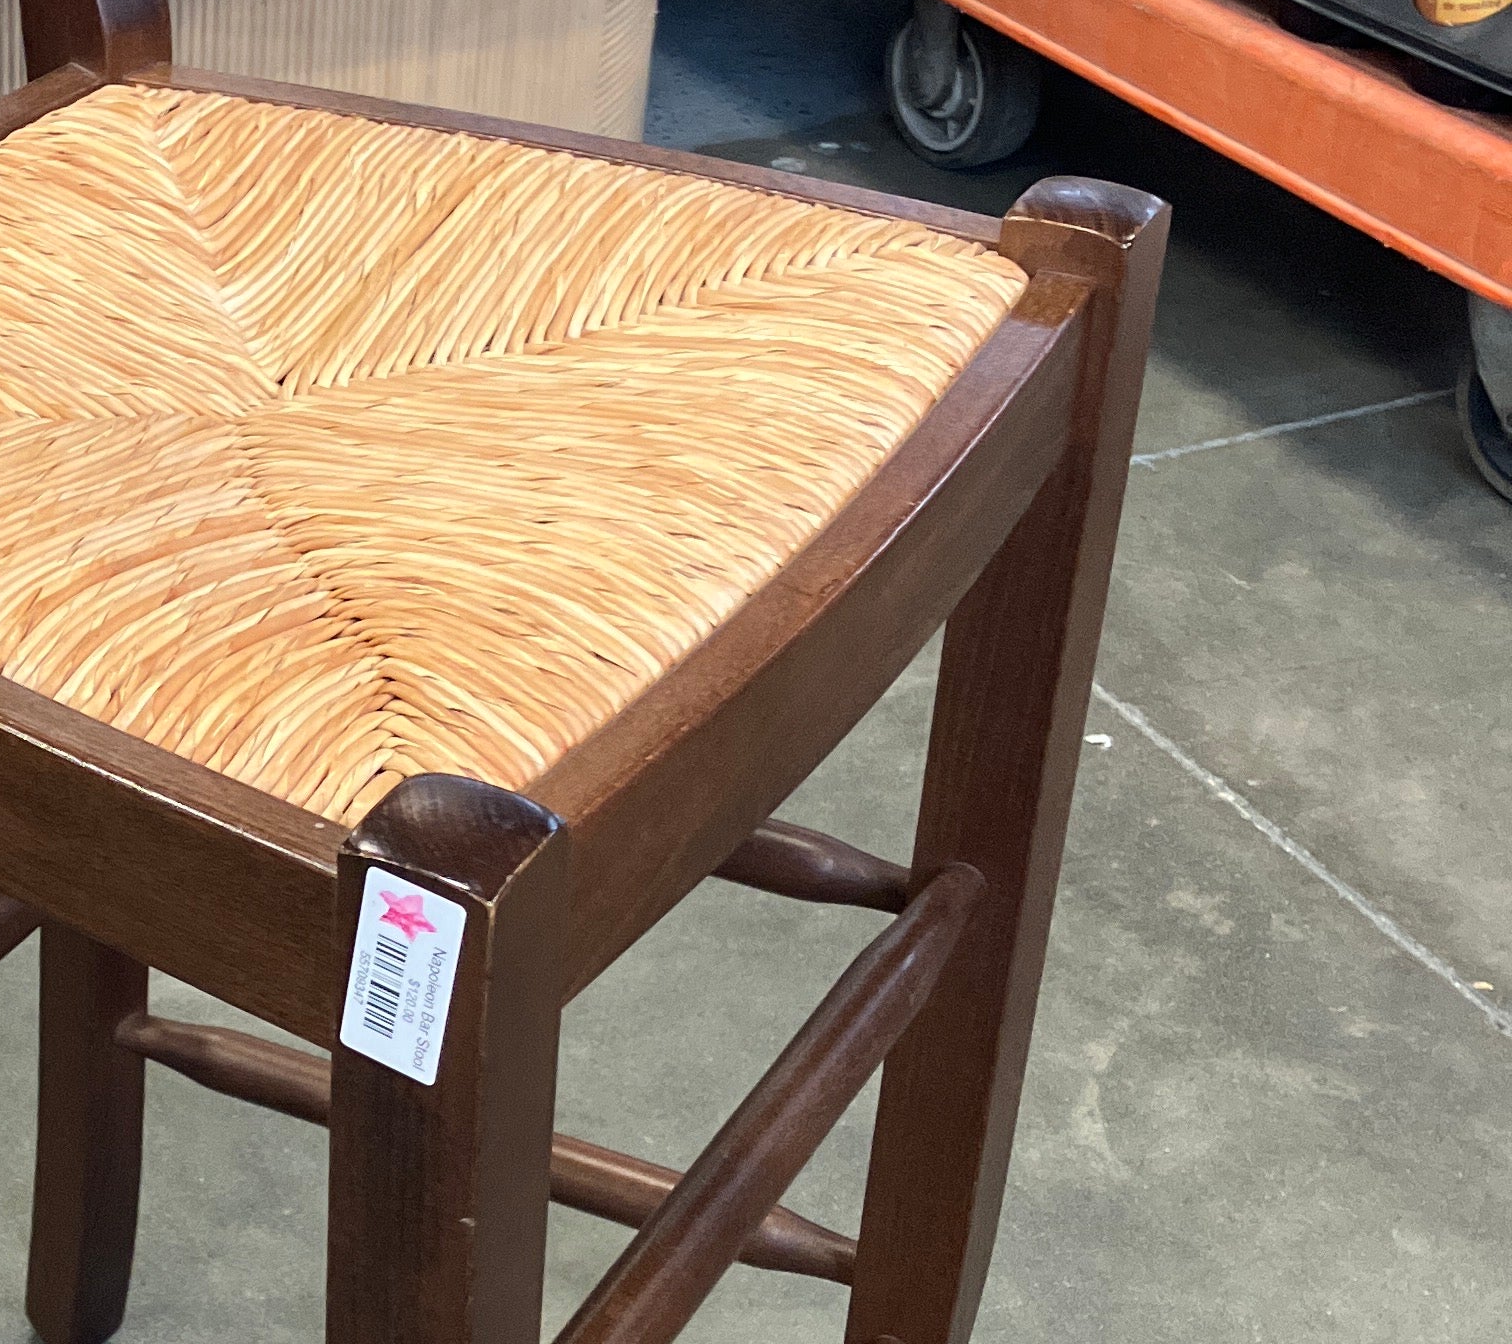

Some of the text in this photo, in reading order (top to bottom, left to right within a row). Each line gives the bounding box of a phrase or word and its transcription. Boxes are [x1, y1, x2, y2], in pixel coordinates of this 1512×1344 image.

[353, 949, 372, 1006] 55709347
[402, 977, 421, 1024] $120.00
[412, 946, 447, 1073] Napoleon Bar Stool
